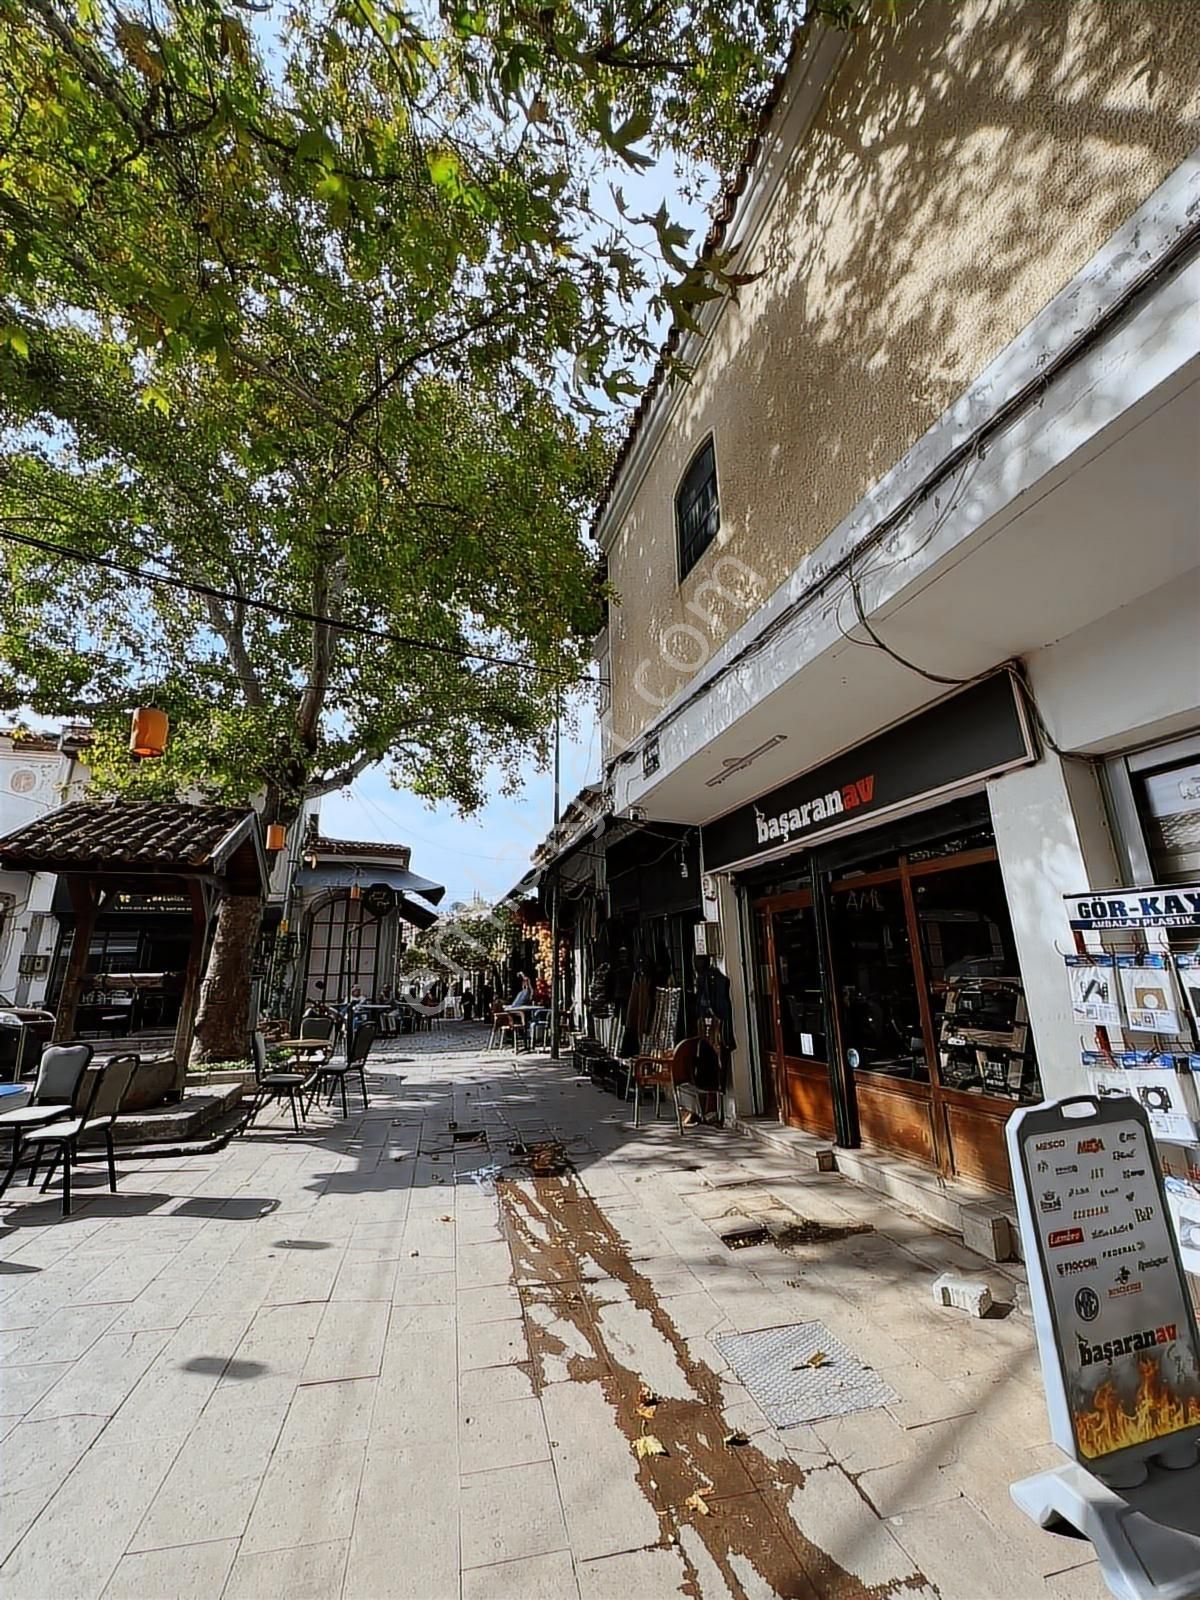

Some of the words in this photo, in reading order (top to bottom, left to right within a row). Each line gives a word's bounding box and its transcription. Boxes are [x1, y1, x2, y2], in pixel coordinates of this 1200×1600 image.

[1077, 893, 1200, 919] GÖR-KAY
[1091, 918, 1140, 929] AMBALAJ
[1035, 1139, 1066, 1151] MESCO
[1102, 1244, 1137, 1259] FEDERAL
[1077, 1323, 1177, 1367] başaranav
